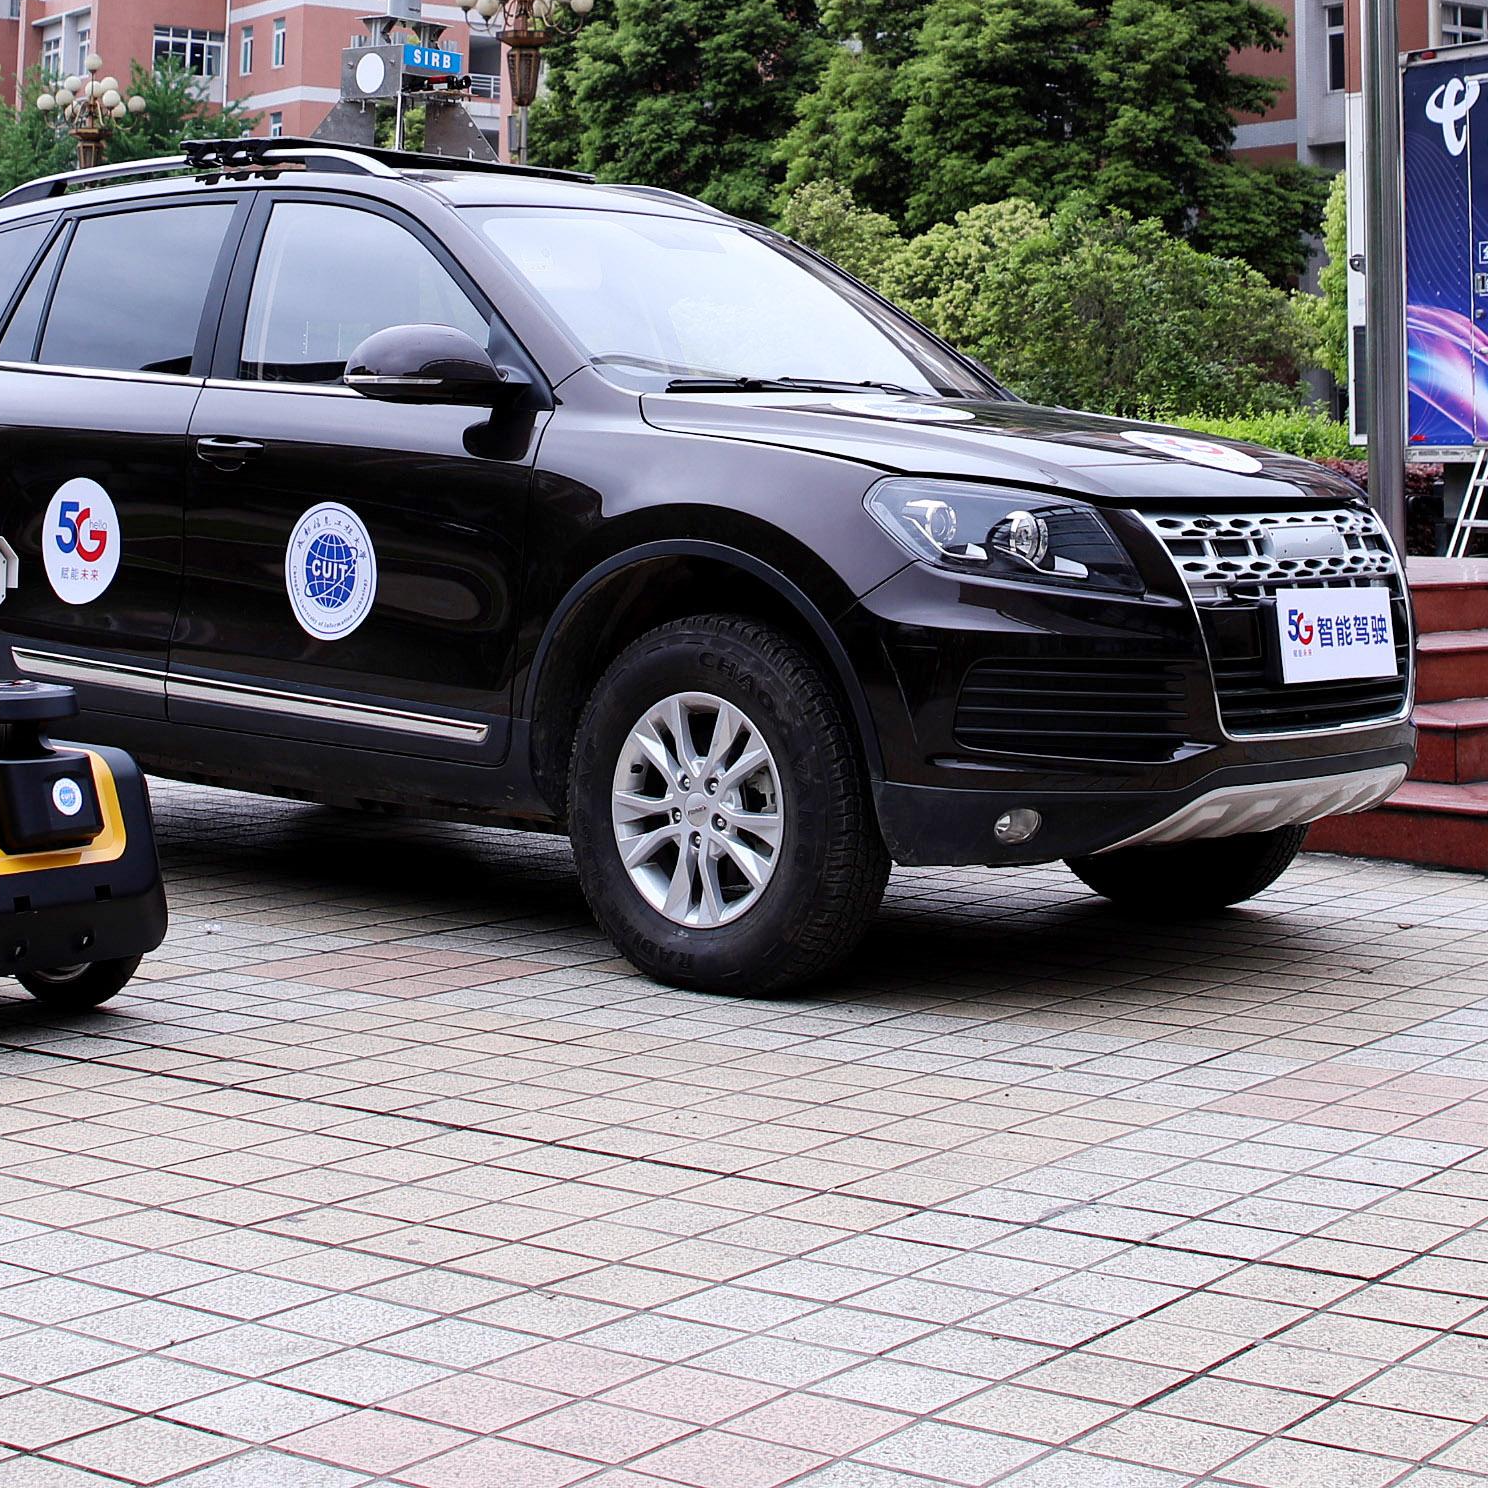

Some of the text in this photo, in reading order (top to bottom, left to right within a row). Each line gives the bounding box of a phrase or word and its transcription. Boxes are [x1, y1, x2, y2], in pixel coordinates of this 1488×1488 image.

[413, 48, 452, 69] SIRB
[55, 500, 108, 563] 5G
[88, 518, 108, 530] hello
[60, 567, 100, 581] 赋能未来
[311, 559, 349, 582] CUIT
[1317, 614, 1389, 648] 智能驾驶
[698, 651, 776, 710] CHAO
